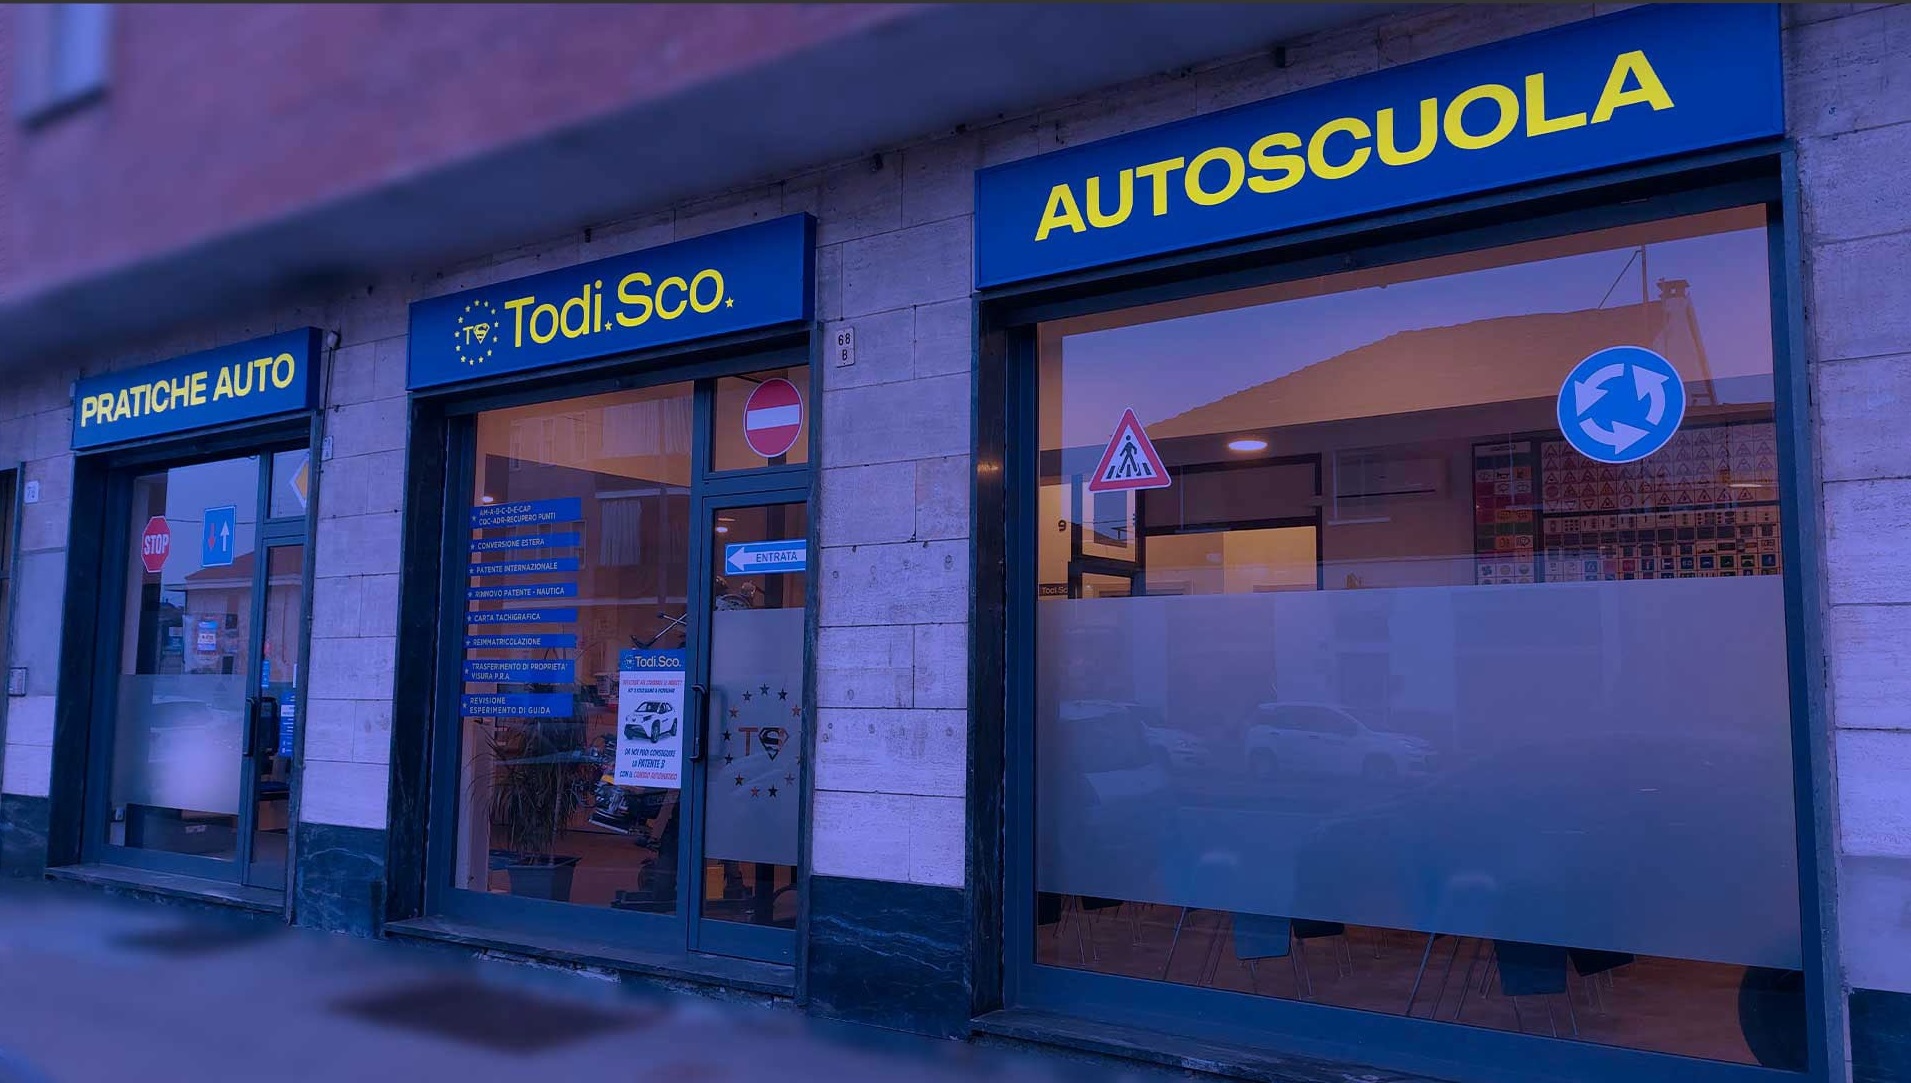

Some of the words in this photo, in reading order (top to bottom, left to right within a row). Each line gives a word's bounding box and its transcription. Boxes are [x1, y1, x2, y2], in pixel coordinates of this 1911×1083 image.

[1034, 49, 1676, 242] AUTOSCUOLA
[838, 332, 851, 346] 68
[842, 349, 848, 361] B
[80, 370, 208, 428] PRATICHE
[212, 353, 296, 400] AUTO
[538, 512, 556, 521] PUNTI
[142, 531, 170, 557] STOP
[477, 539, 520, 550] CONVERSIONE
[521, 538, 545, 547] ESTERA
[756, 551, 798, 563] ENTRATA
[476, 563, 503, 574] PATENTE
[503, 561, 558, 572] INTERNAZIONALE
[475, 589, 503, 598] RINNOVO
[503, 588, 531, 597] PATENTE
[536, 587, 565, 596] NAUTICA
[474, 614, 495, 623] CARTA
[495, 612, 541, 622] TACHIGRAFICA
[473, 637, 542, 647] REIMMATRICOLAZIONE
[472, 662, 521, 672] TRASFERIMENTO
[522, 662, 529, 671] DI
[471, 672, 494, 681] VISURA
[470, 696, 506, 705] REVISIONE
[469, 705, 517, 715] ESPERIMENTO
[518, 706, 526, 715] DI
[527, 706, 551, 715] GUIDA
[637, 758, 660, 769] PATENTE
